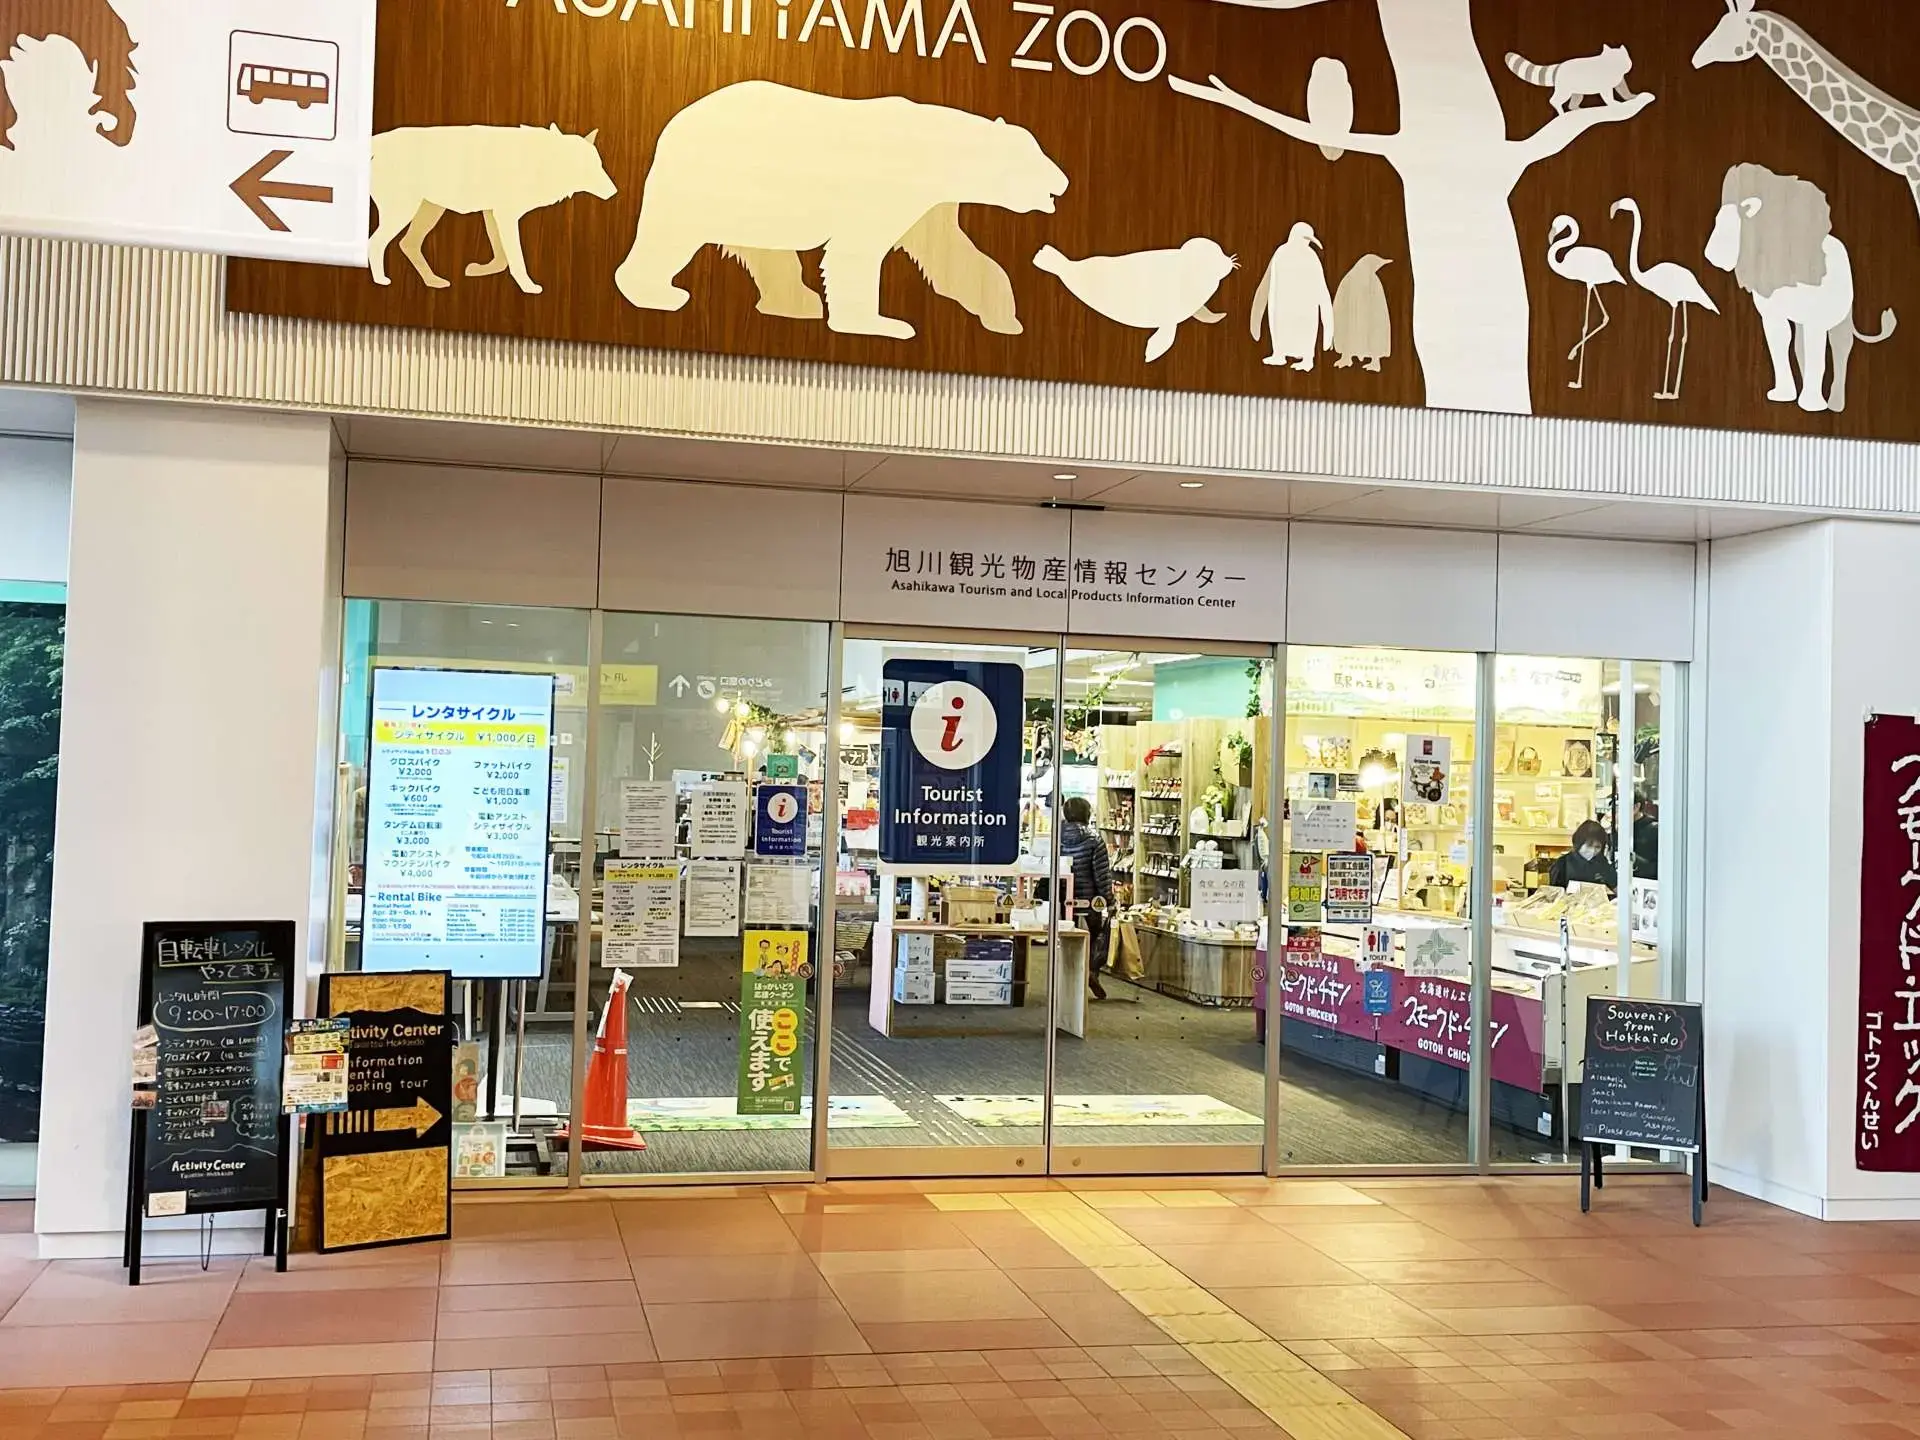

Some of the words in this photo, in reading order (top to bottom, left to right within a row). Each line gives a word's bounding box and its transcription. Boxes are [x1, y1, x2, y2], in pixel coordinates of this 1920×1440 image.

[1011, 2, 1167, 82] ZOO
[885, 547, 1246, 588] 旭川観光物産情報センター
[892, 579, 955, 593] Asahikawa
[959, 583, 1007, 596] Tourism
[1010, 587, 1032, 597] and
[1036, 588, 1067, 599] Local
[1071, 589, 1122, 602] Products
[1126, 592, 1194, 606] Information
[1199, 596, 1236, 608] Center
[412, 705, 516, 721] レンタサイクル
[395, 731, 464, 741] シティサイクル
[390, 758, 440, 766] クロスバイク
[474, 761, 532, 769] ファットバイク
[390, 784, 441, 793] キックバイク
[922, 786, 983, 801] Tourist
[895, 809, 1007, 825] Information
[474, 822, 531, 831] シティサイクル
[916, 834, 985, 848] 観光案内所
[384, 859, 452, 868] マウンテンバイク
[378, 892, 415, 901] Rental
[418, 892, 442, 901] Bike
[1329, 888, 1370, 901] ご利用できます
[158, 936, 273, 967] 自転車レンタル
[754, 982, 794, 991] ほっかいどう
[1607, 1004, 1671, 1022] Souvenir
[350, 1025, 389, 1040] tivity
[393, 1023, 444, 1037] Center
[1624, 1021, 1654, 1032] from
[1606, 1031, 1679, 1046] Hokkaido
[748, 1008, 775, 1092] 使えます
[1417, 1037, 1444, 1055] GOTOH
[165, 1051, 211, 1062] クロスバイク
[350, 1055, 423, 1068] formation
[349, 1068, 385, 1080] ental
[1861, 1011, 1884, 1150] ゴトウくんせい
[348, 1080, 392, 1093] ooking
[400, 1080, 428, 1089] tour
[172, 1161, 212, 1173] Activity
[213, 1160, 246, 1171] Center
